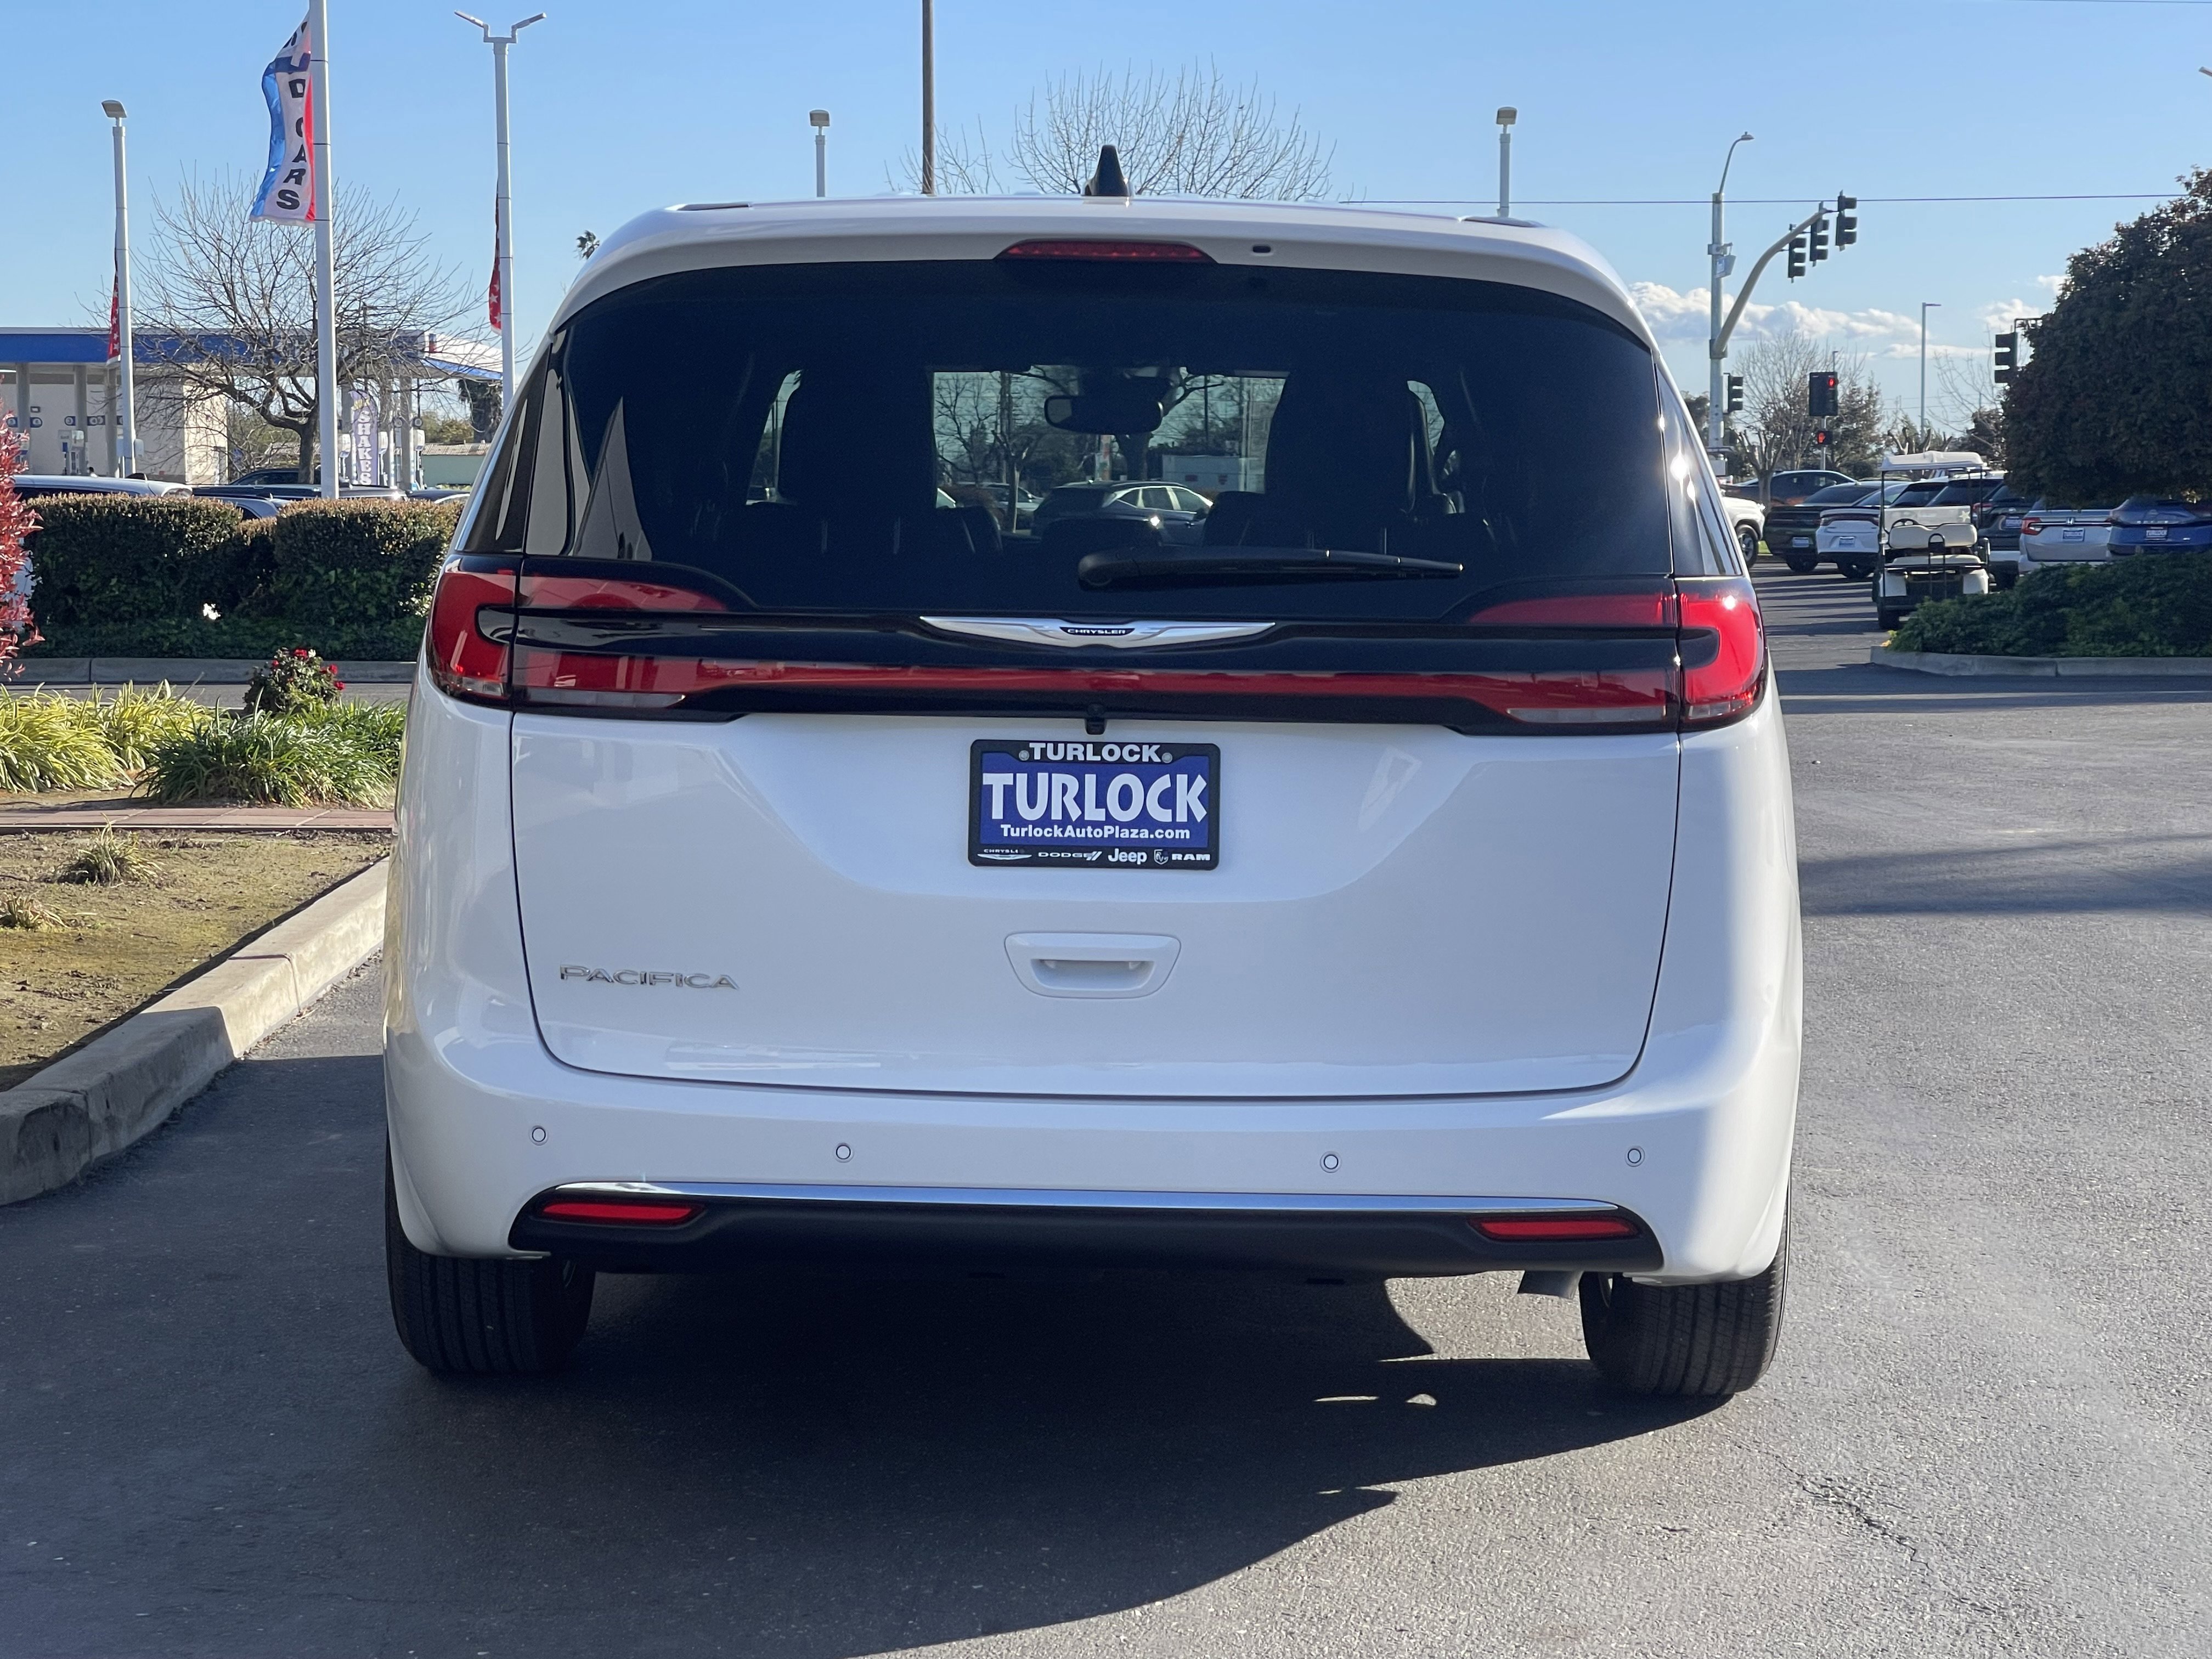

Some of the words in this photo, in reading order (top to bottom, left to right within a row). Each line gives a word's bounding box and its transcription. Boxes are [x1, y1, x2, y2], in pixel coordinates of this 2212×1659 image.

[357, 410, 373, 486] SHAKES
[1029, 742, 1161, 763] TURLOCK
[983, 772, 1207, 822] TURLOCK
[1000, 824, 1190, 839] TurlockAutoPlaza.com
[1108, 848, 1148, 865] Jeep
[559, 964, 740, 990] PACIFICA
